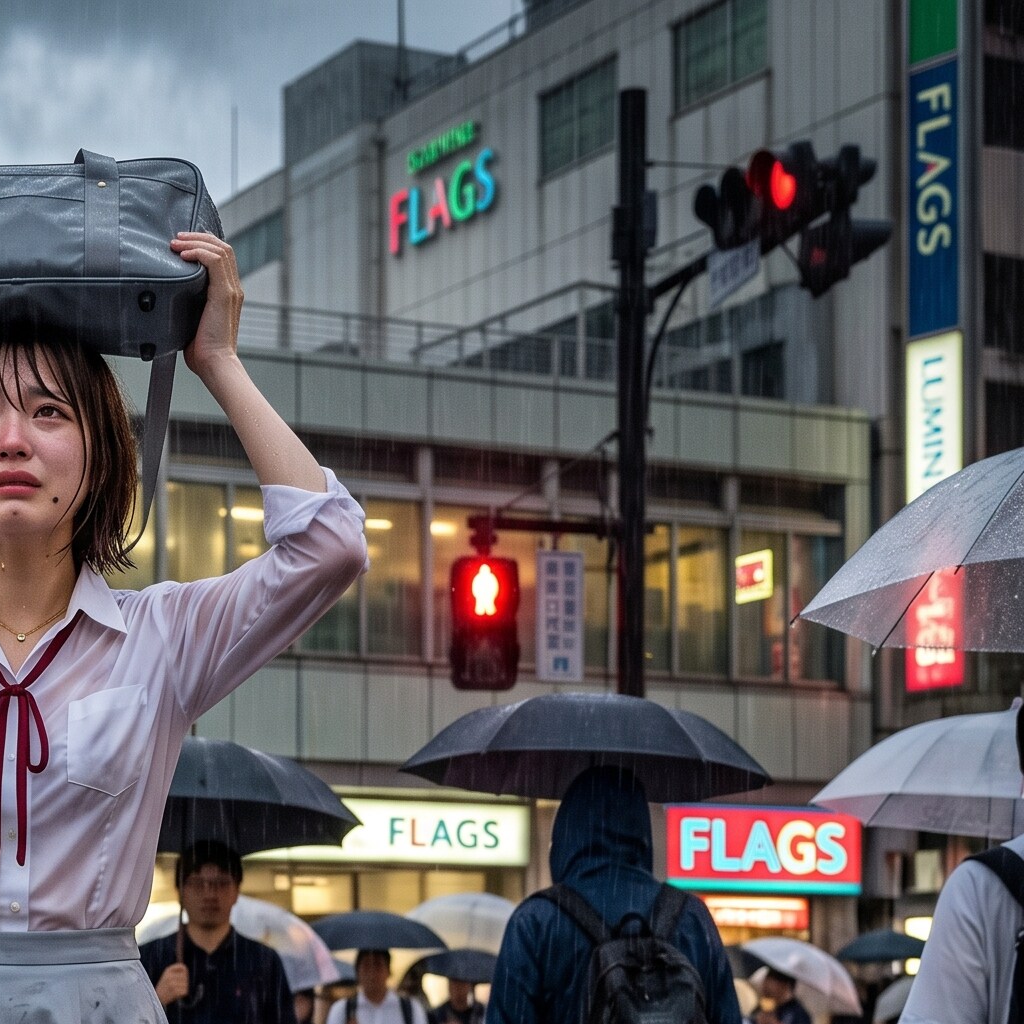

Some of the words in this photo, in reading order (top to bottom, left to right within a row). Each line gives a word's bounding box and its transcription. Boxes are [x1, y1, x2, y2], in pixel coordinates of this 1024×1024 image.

[389, 147, 495, 255] FLAGS
[916, 83, 952, 256] FLAGS
[921, 356, 943, 480] LUMIN
[389, 817, 499, 849] FLAGS
[680, 817, 849, 875] FLAGS
